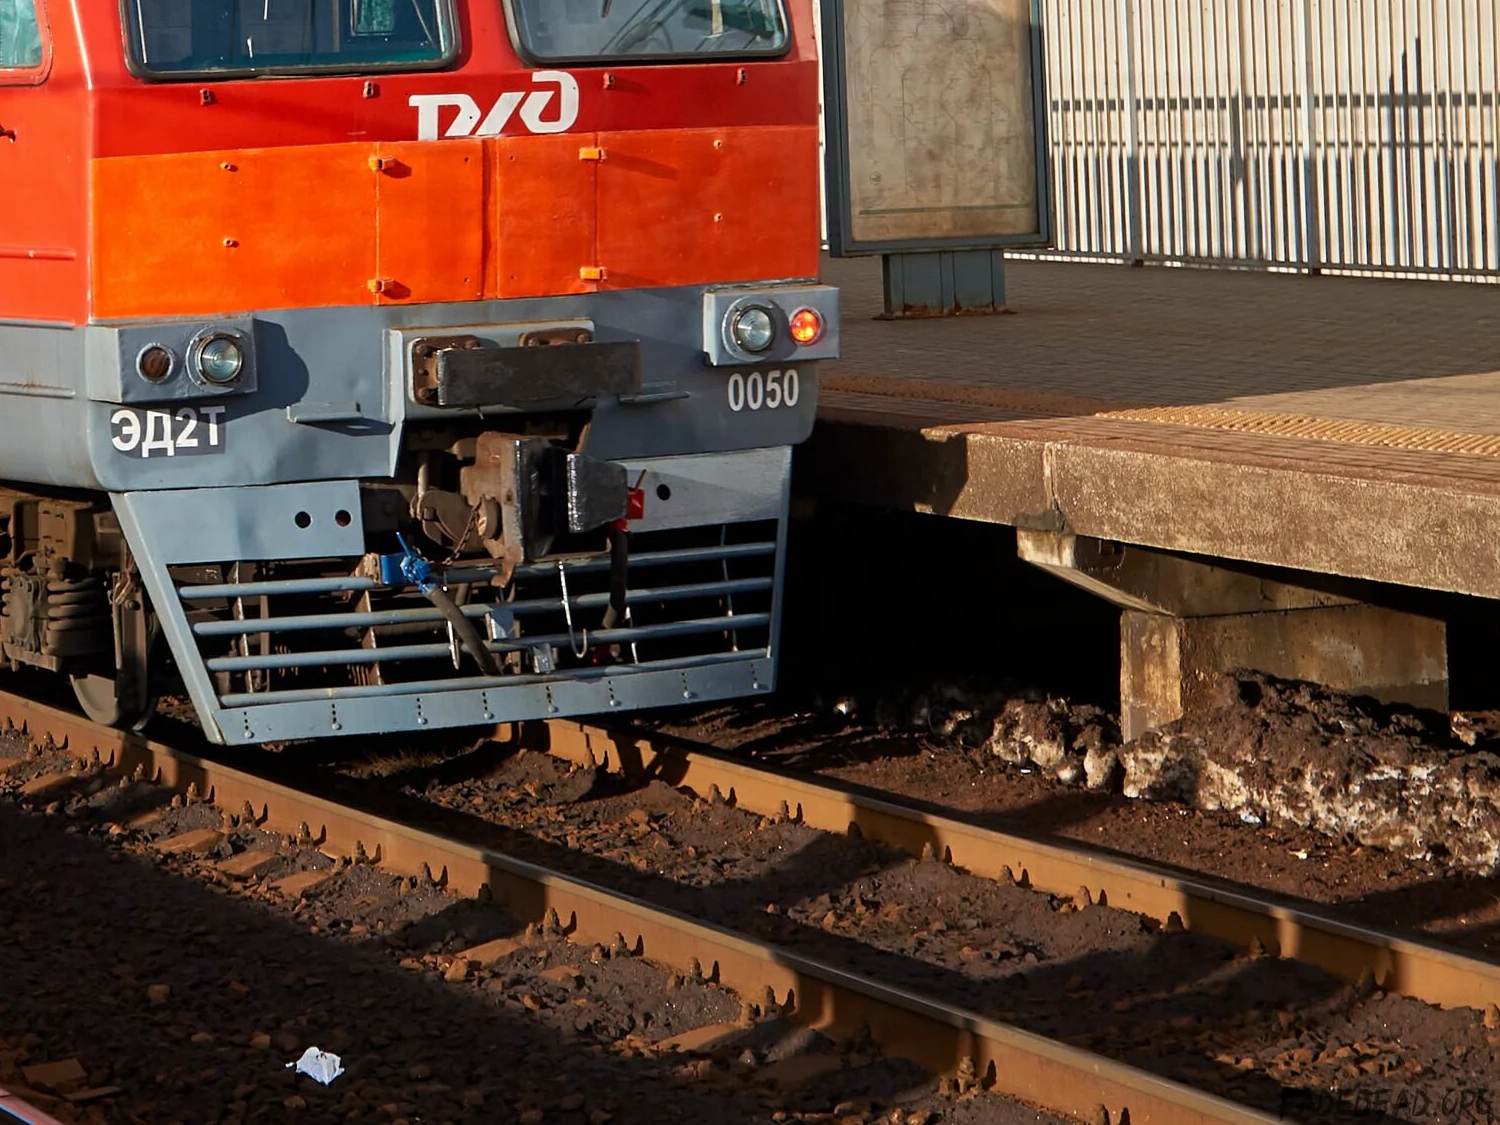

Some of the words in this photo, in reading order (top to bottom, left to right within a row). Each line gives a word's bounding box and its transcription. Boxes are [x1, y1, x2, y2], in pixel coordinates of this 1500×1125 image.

[409, 70, 579, 141] РЖД
[728, 369, 799, 411] 0050
[110, 405, 226, 458] ЭД2Т
